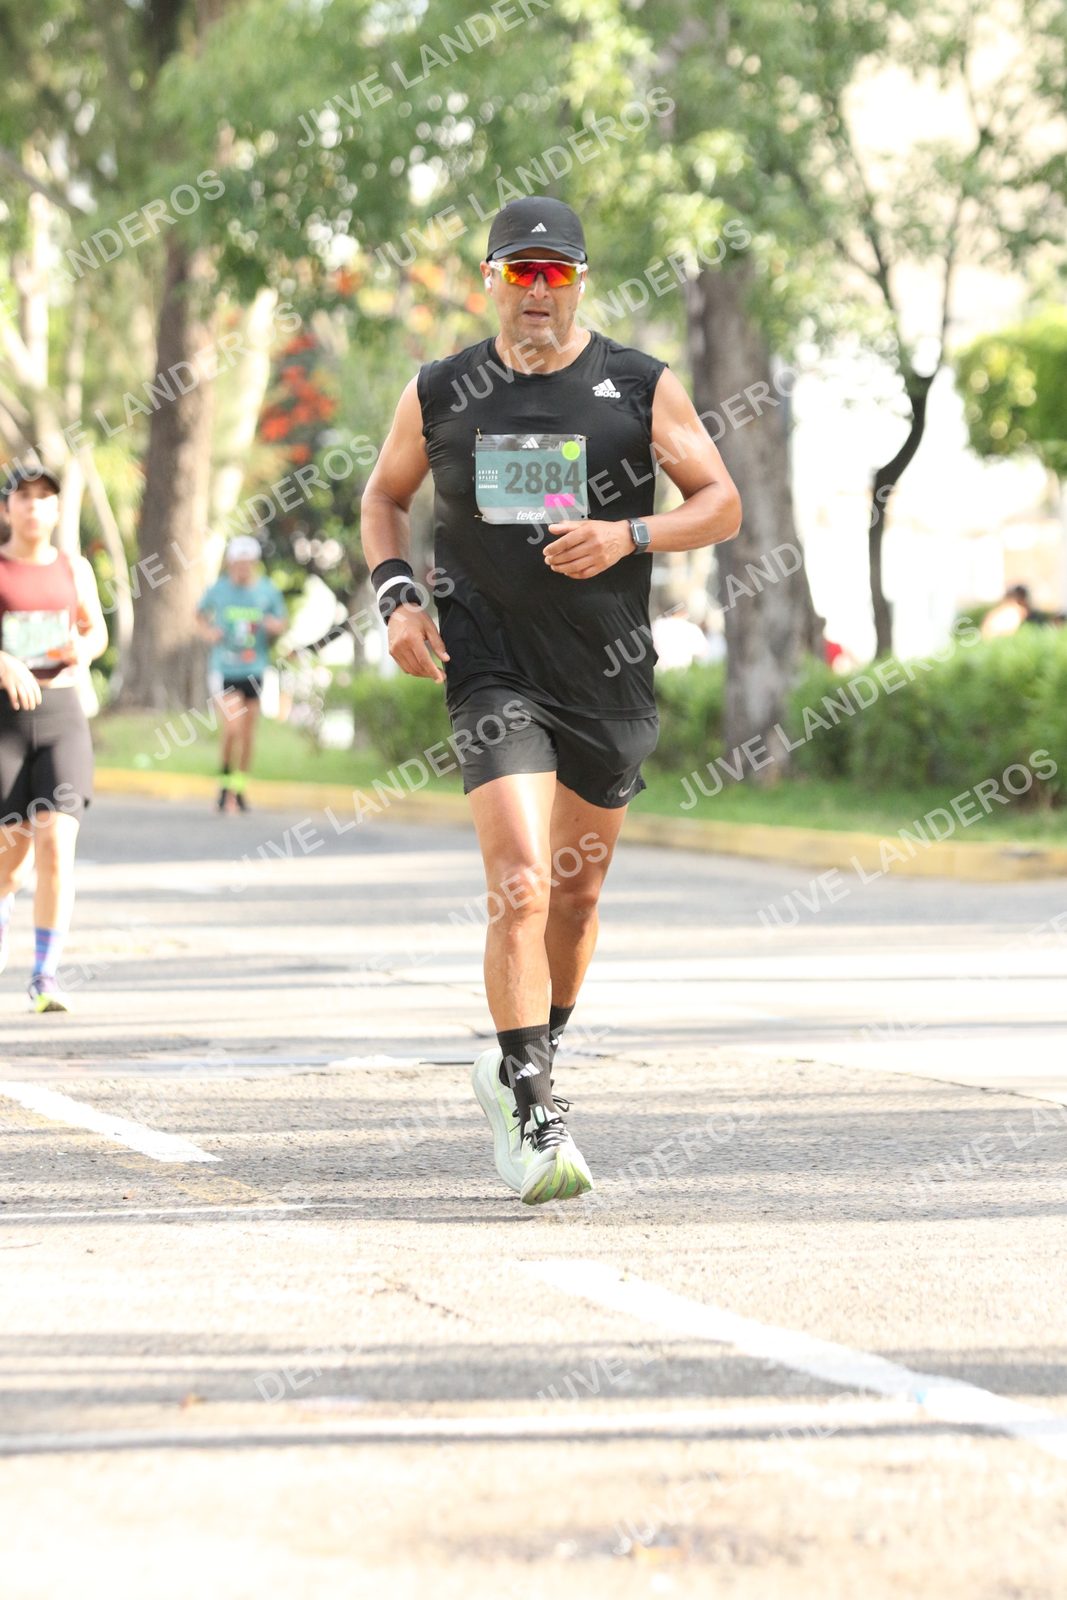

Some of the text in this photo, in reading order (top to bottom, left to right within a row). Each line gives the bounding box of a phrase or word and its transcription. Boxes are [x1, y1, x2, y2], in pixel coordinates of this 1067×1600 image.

[594, 389, 622, 398] adidas
[505, 461, 582, 494] 2884
[516, 510, 546, 521] telcel
